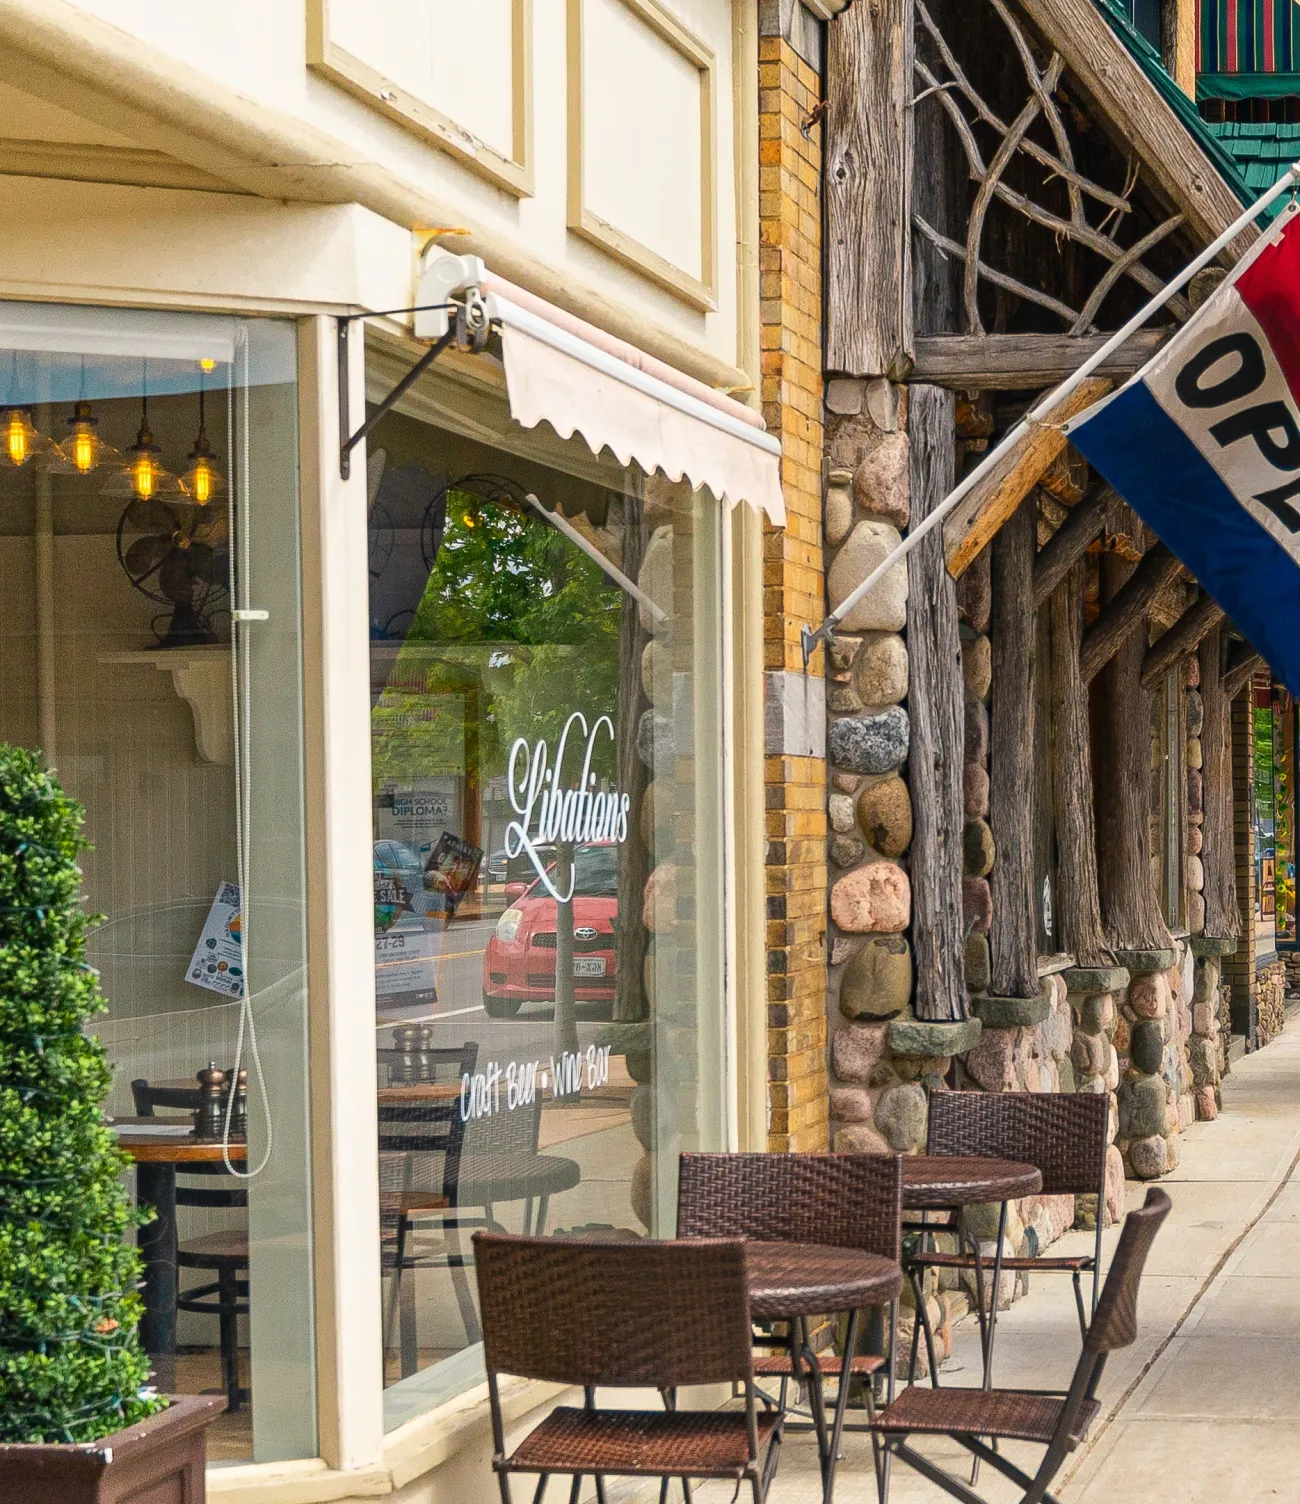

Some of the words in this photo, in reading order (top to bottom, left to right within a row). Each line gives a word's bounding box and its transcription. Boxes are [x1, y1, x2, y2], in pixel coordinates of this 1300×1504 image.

[505, 711, 630, 903] Libations
[380, 890, 406, 904] SALE
[460, 1061, 503, 1122] Craft
[505, 1059, 540, 1111] Beer
[550, 1050, 583, 1098] Wine
[586, 1044, 612, 1091] Bar
